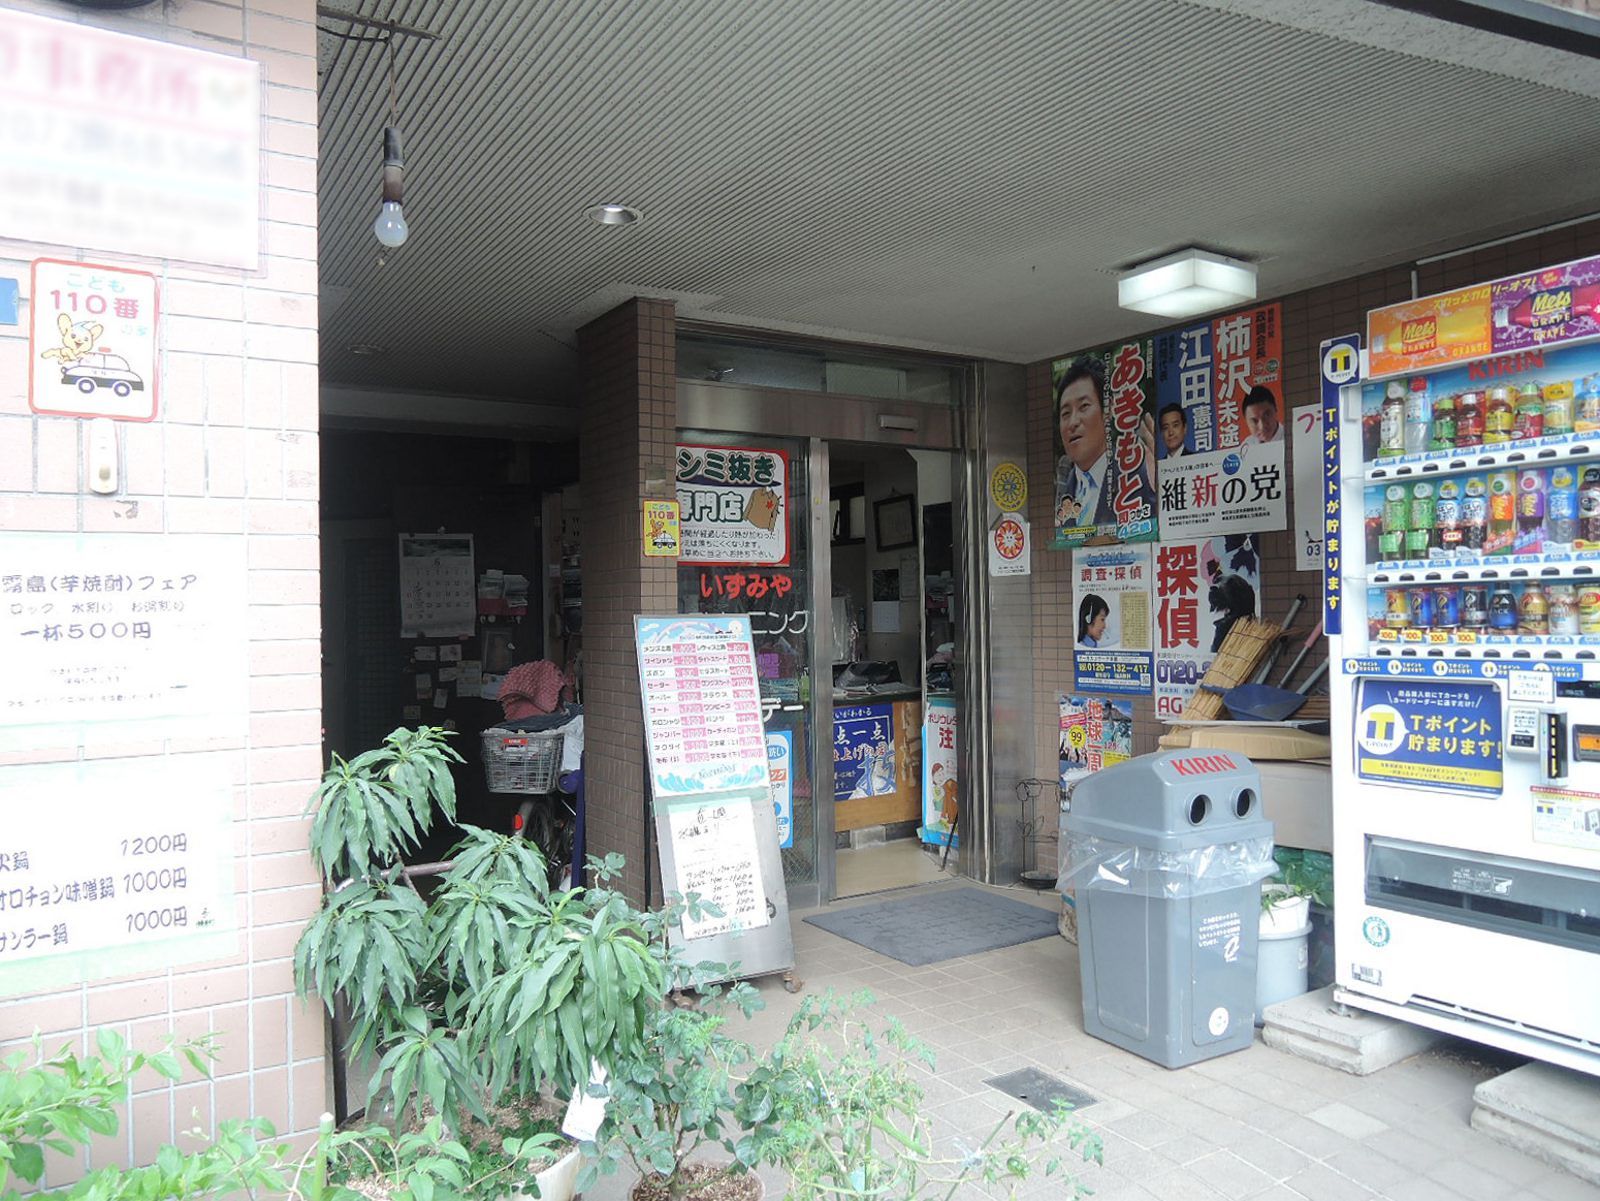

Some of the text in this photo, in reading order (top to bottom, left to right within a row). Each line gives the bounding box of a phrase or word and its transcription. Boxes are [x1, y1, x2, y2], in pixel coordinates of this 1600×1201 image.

[66, 273, 126, 294] こども
[50, 289, 140, 319] 110番
[1532, 291, 1572, 313] Mets
[1403, 321, 1437, 342] Mets
[1532, 314, 1571, 328] GRAPE
[1533, 326, 1567, 342] GRAPE
[1467, 350, 1545, 381] KIRIN
[1178, 326, 1213, 451] 江田憲司
[1216, 315, 1253, 448] 柿沢未途
[1111, 343, 1146, 513] あきもと
[1160, 464, 1282, 512] 維新の党
[647, 511, 675, 520] 110番
[1325, 408, 1341, 611] Tポイントが貯まります
[1306, 544, 1321, 557] 03
[1080, 565, 1143, 582] 調査・探偵
[701, 572, 793, 600] いずみや
[1156, 545, 1200, 650] 探偵
[1157, 697, 1183, 714] AG
[1087, 699, 1104, 772] 地球一周
[1409, 714, 1492, 736] Tポイント
[938, 727, 954, 750] 注
[1407, 733, 1503, 758] 貯まります!
[1169, 753, 1237, 777] KIRIN
[120, 833, 188, 856] 1200円
[123, 866, 188, 894] 1000円
[126, 905, 188, 933] 1000円
